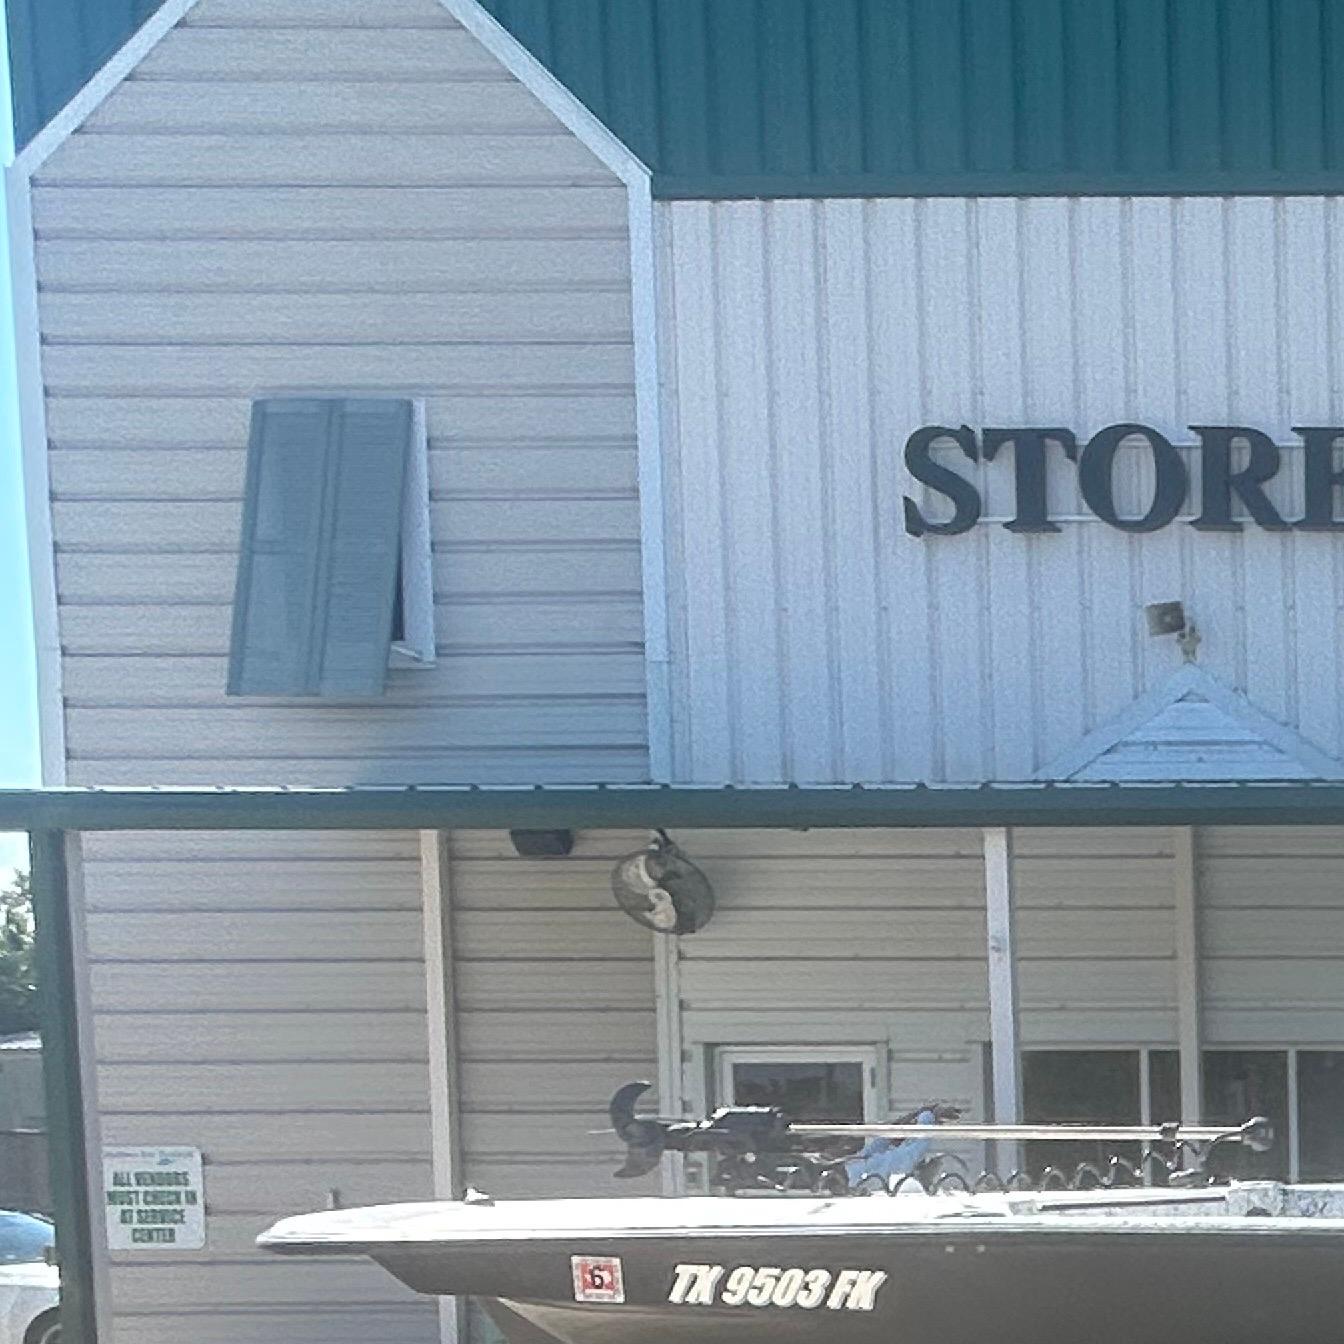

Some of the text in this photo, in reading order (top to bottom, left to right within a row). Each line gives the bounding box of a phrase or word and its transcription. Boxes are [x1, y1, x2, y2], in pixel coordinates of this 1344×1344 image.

[112, 1171, 132, 1187] ALL
[668, 1264, 724, 1305] TX
[721, 1266, 832, 1309] 9503
